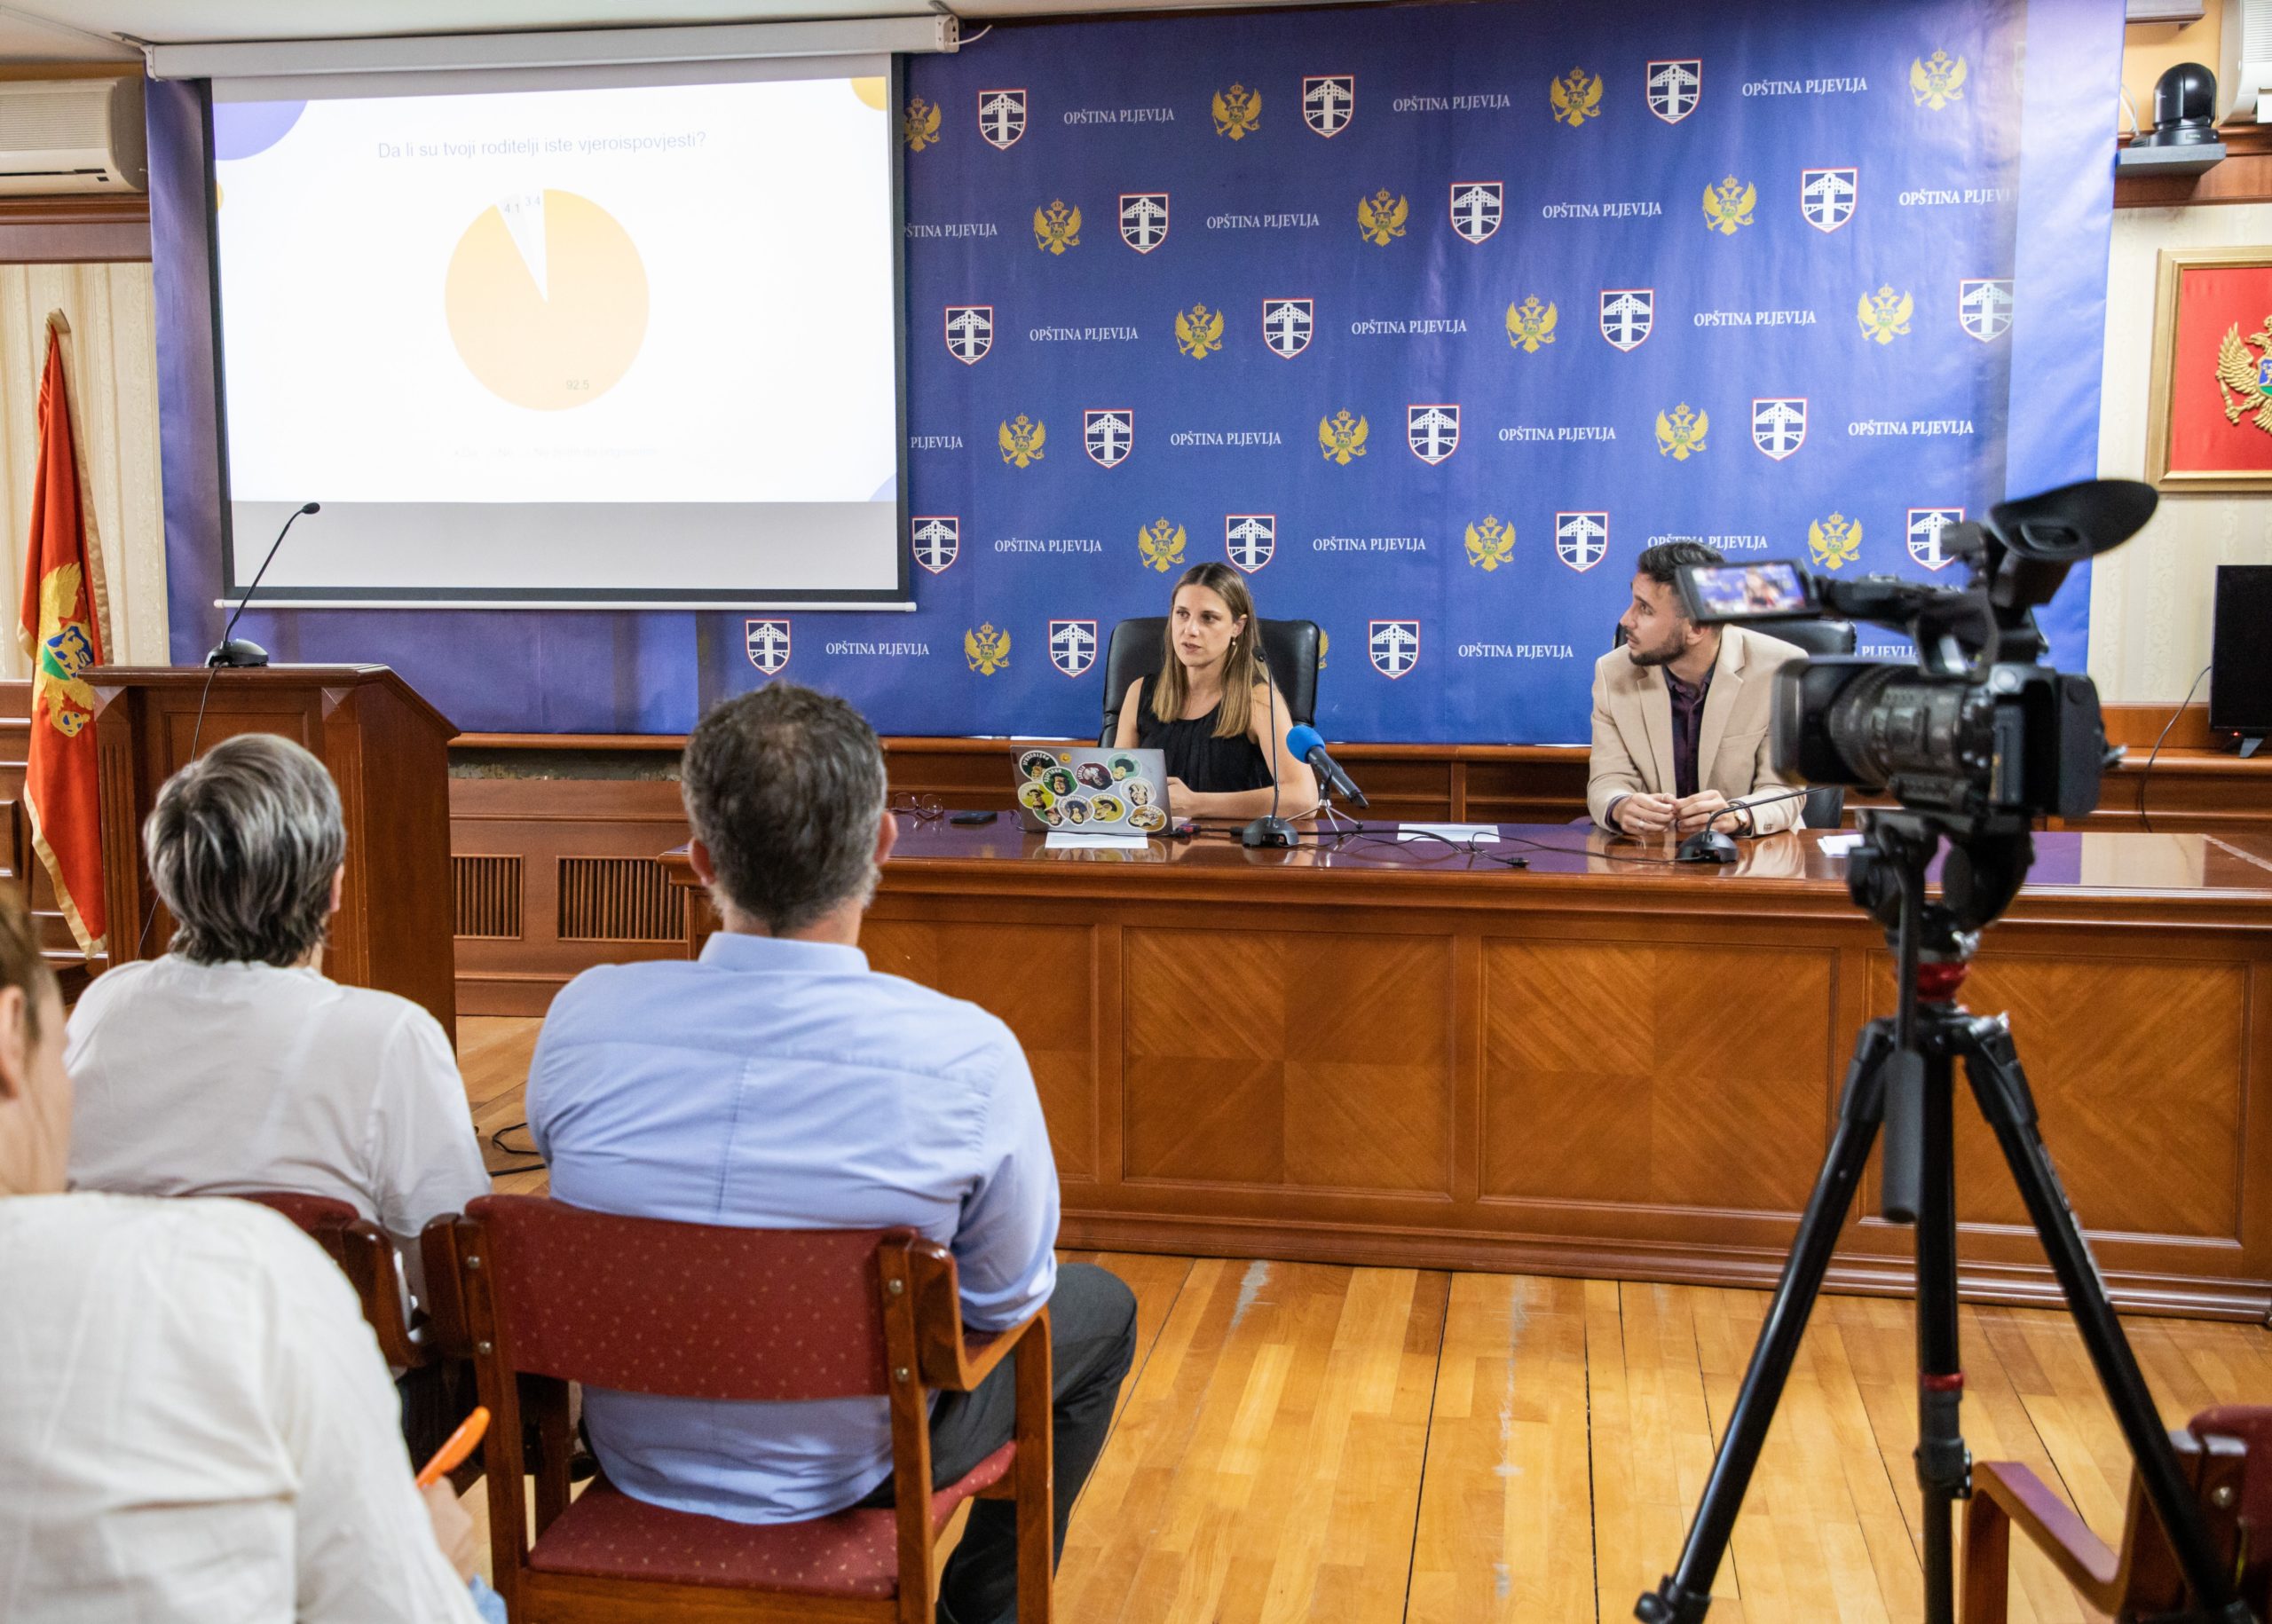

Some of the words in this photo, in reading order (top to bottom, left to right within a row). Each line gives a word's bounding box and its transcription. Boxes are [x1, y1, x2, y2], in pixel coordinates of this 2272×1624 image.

[1741, 79, 1803, 97] OPŠTINA
[1805, 77, 1868, 95] PLJEVLJA
[1392, 95, 1449, 113] OPŠTINA
[1452, 93, 1511, 111] PLJEVLJA
[1063, 108, 1117, 125] OPŠTINA
[1119, 107, 1175, 125] PLJEVLJA
[378, 142, 401, 159] Da
[406, 141, 414, 157] li
[419, 144, 438, 157] su
[443, 138, 476, 160] tvoji
[481, 137, 540, 157] roditelji
[544, 136, 573, 153] iste
[578, 130, 707, 157] vjeroispovjesti?
[1898, 187, 1961, 206] OPŠTINA
[1542, 201, 1600, 219] OPŠTINA
[1602, 201, 1662, 219] PLJEVLJA
[1206, 213, 1261, 229] OPŠTINA
[1263, 213, 1320, 229] PLJEVLJA
[905, 223, 943, 238] ŠTINA
[944, 223, 998, 239] PLJEVLJA
[1351, 319, 1407, 335] OPŠTINA
[1408, 319, 1467, 335] PLJEVLJA
[1693, 310, 1753, 327] OPŠTINA
[1755, 310, 1817, 327] PLJEVLJA
[1029, 326, 1082, 342] OPŠTINA
[1085, 327, 1139, 343] PLJEVLJA
[1498, 425, 1556, 442] OPŠTINA
[1557, 426, 1617, 443] PLJEVLJA
[1848, 419, 1909, 436] OPŠTINA
[1911, 420, 1975, 438] PLJEVLJA
[910, 436, 964, 451] PLJEVLJA
[1170, 430, 1224, 446] OPŠTINA
[1227, 431, 1282, 447] PLJEVLJA
[994, 537, 1046, 553] OPŠTINA
[1048, 539, 1102, 555] PLJEVLJA
[1312, 535, 1368, 551] OPŠTINA
[1369, 537, 1426, 553] PLJEVLJA
[1708, 534, 1769, 551] PLJEVLJA
[825, 640, 877, 655] OPŠTINA
[877, 643, 930, 658] PLJEVLJA
[1457, 642, 1514, 658] OPŠTINA
[1516, 644, 1574, 660] PLJEVLJA
